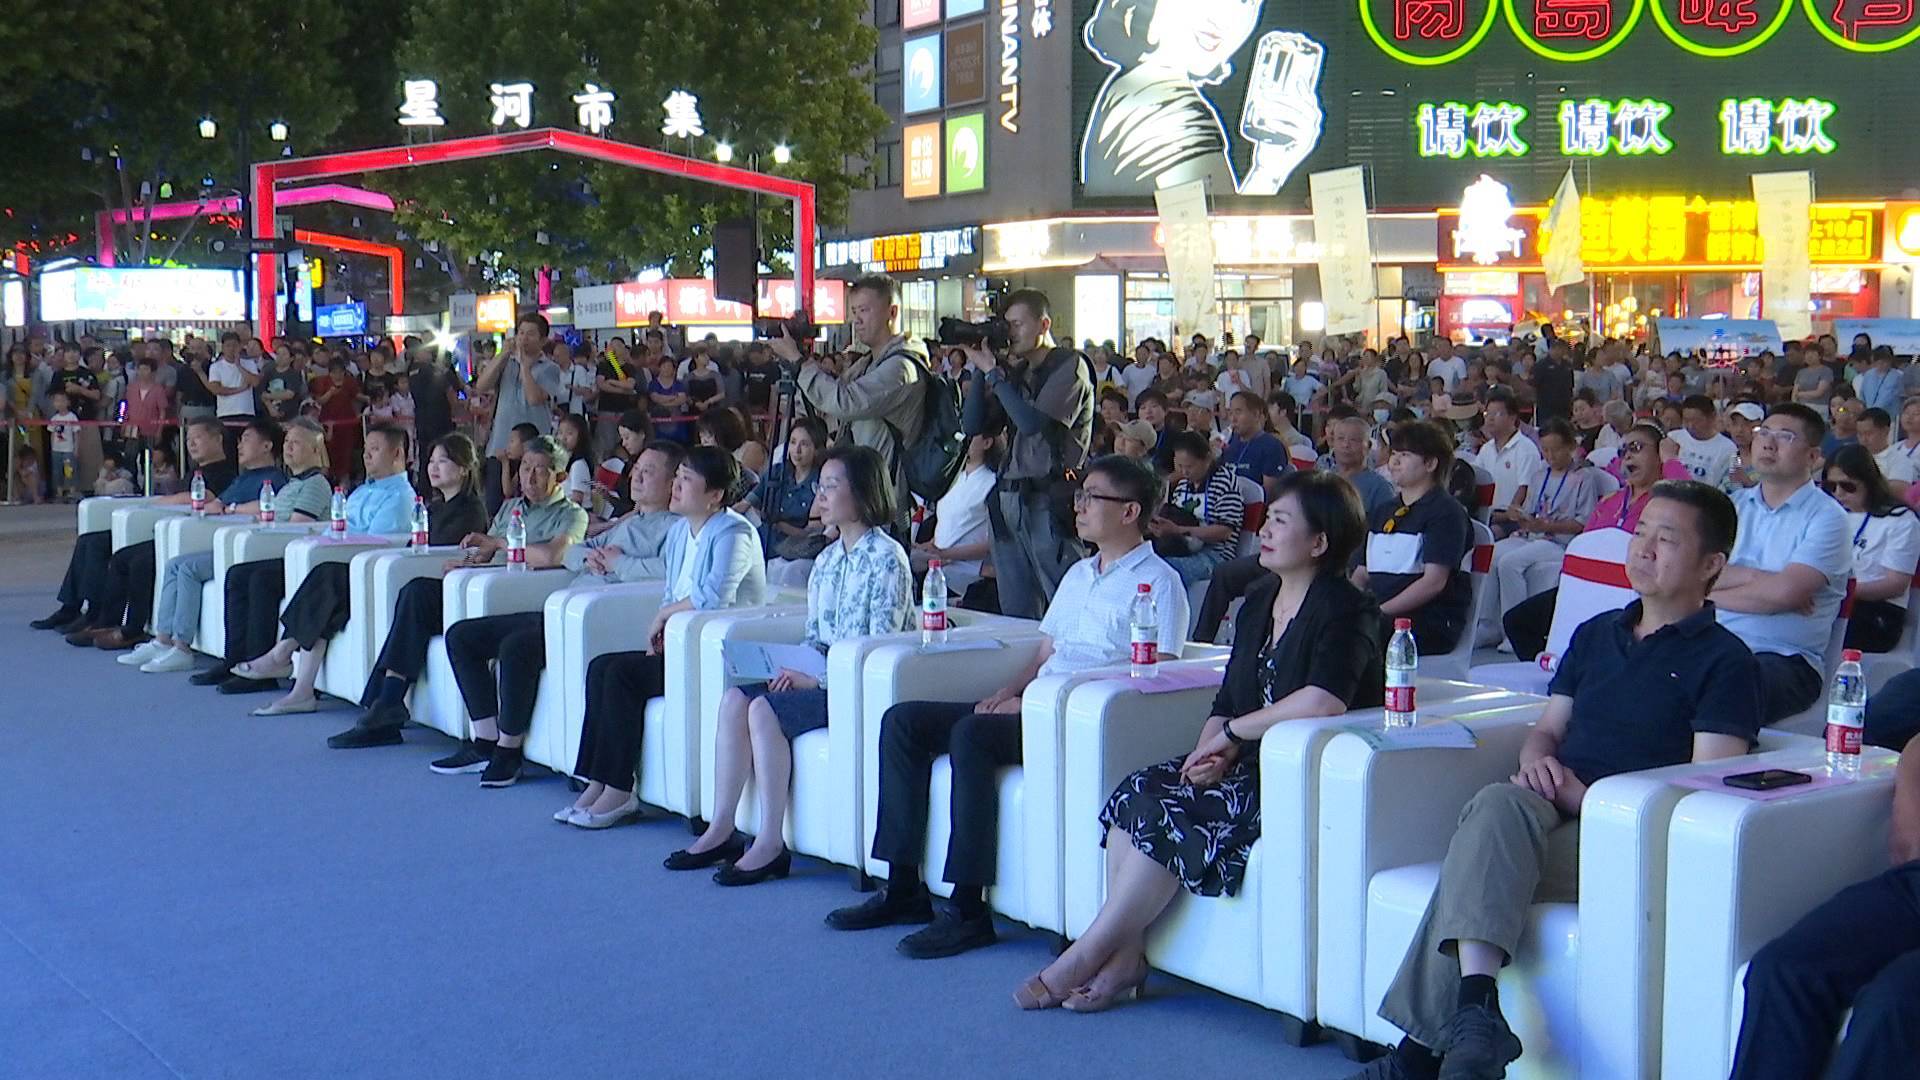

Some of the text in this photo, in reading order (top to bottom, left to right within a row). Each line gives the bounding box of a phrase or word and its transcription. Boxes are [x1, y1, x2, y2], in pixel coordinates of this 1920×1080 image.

[398, 80, 705, 138] 星河市集
[1418, 99, 1835, 156] 请饮 请饮 请饮
